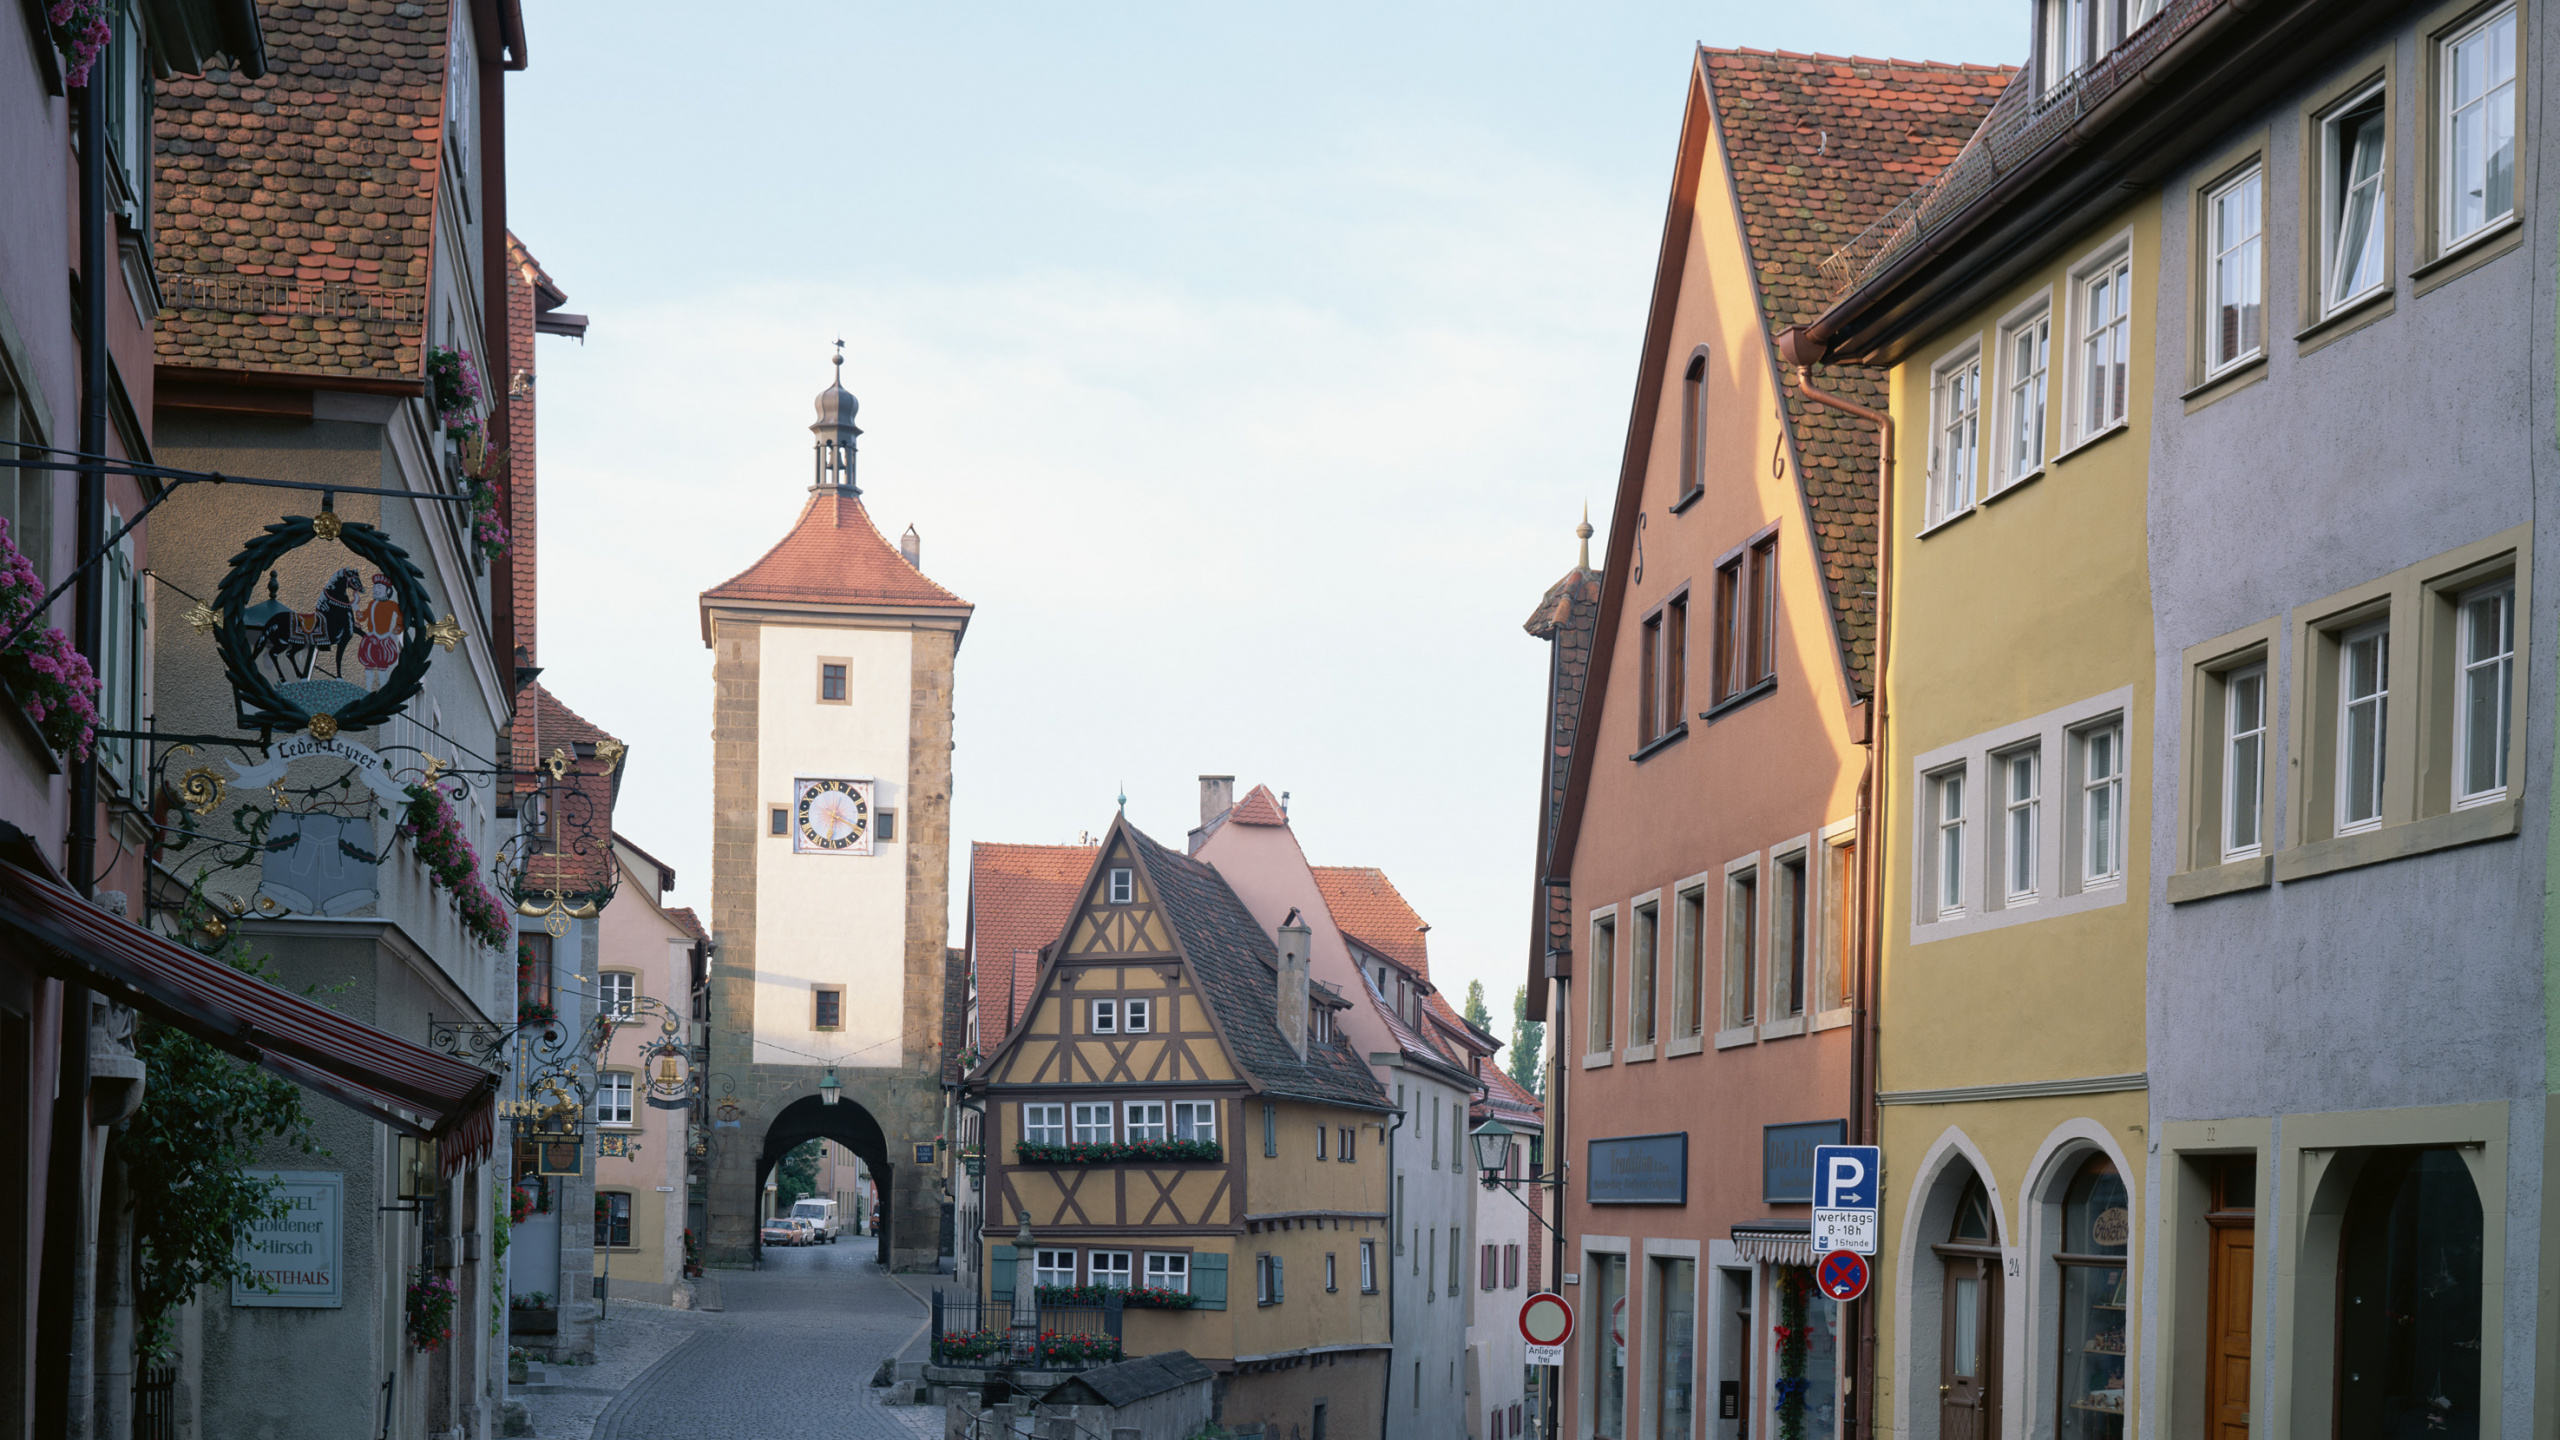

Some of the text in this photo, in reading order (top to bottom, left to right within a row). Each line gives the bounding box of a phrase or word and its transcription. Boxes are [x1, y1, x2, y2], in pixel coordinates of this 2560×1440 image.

[2207, 1126, 2216, 1142] 22
[1828, 1156, 1865, 1208] P
[1817, 1212, 1873, 1226] werktags
[262, 1239, 314, 1255] Hirsch
[2009, 1257, 2020, 1278] 24
[250, 1269, 330, 1286] ÄSTEHAUS
[1528, 1346, 1562, 1358] Anlieger
[1537, 1355, 1550, 1364] frei
